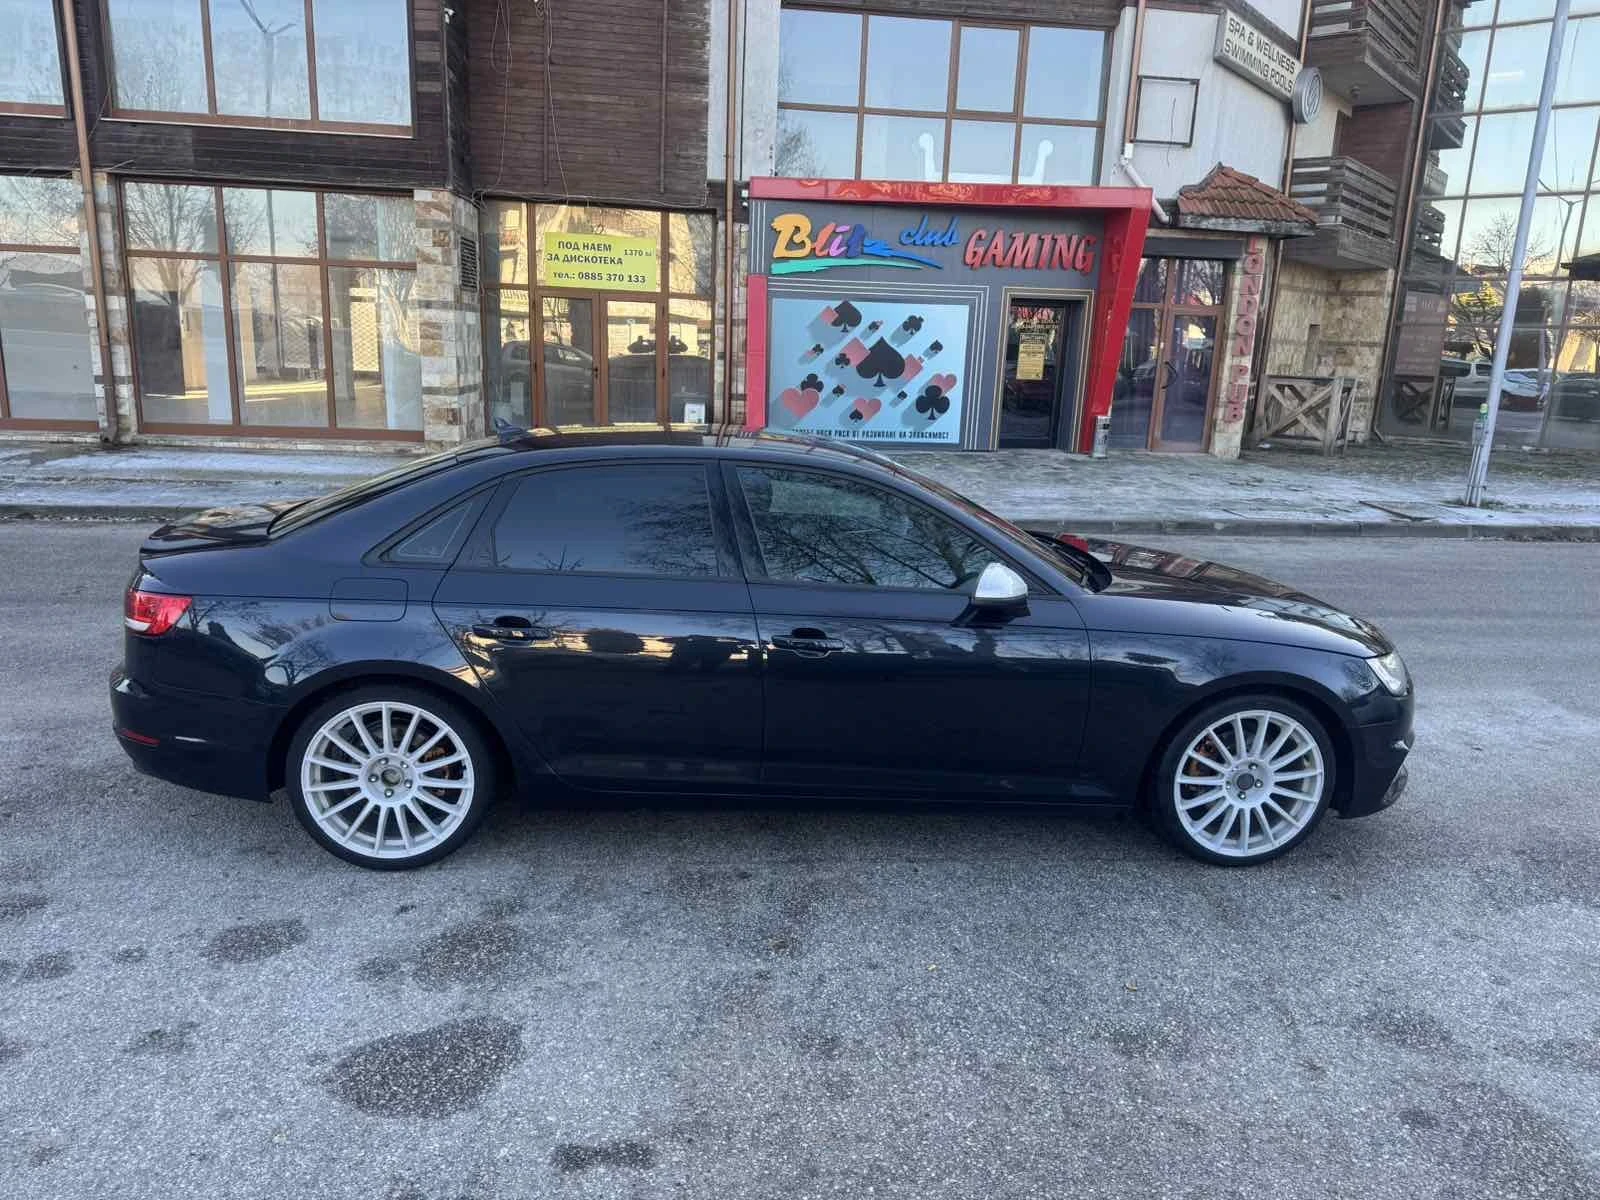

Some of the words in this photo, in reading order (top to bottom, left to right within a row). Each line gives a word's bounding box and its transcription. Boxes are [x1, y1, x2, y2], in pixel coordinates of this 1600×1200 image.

[1224, 38, 1270, 78] SWIMMING
[1270, 69, 1294, 93] POOLS
[1228, 17, 1246, 41] SPA
[1247, 31, 1255, 46] &
[1256, 35, 1296, 74] WELLNESS
[546, 252, 560, 262] ЗА
[562, 254, 623, 265] ДИСКОТЕКА
[558, 240, 580, 250] ПОД
[582, 242, 612, 252] НАЕМ
[898, 212, 960, 247] club
[965, 229, 1097, 274] GAMING
[578, 271, 603, 281] 0885
[605, 273, 625, 282] 370
[627, 274, 647, 283] 133
[1231, 238, 1265, 357] LONDON
[1224, 364, 1249, 424] PUB
